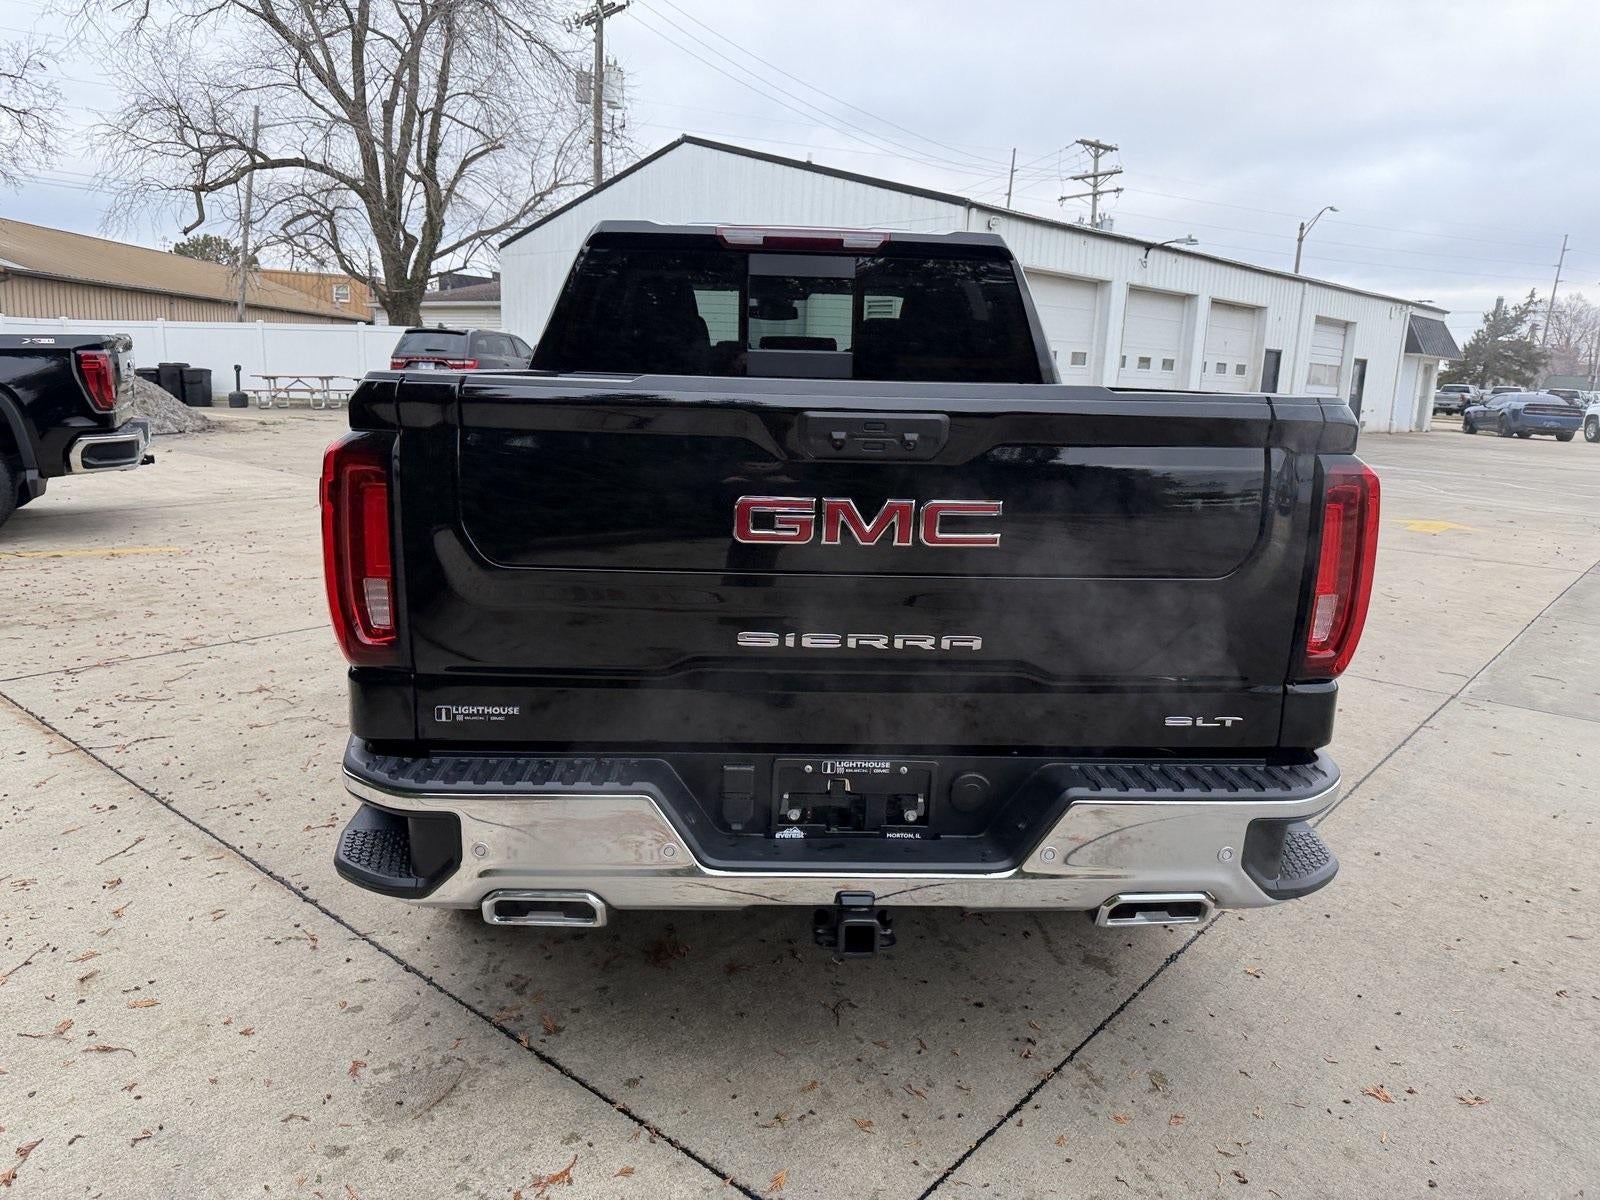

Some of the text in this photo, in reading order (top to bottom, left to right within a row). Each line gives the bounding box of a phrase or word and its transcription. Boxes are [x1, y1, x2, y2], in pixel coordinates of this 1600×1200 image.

[734, 495, 1003, 547] GMC
[737, 631, 982, 650] SIERRA
[452, 705, 519, 715] LIGHTHOUSE
[1165, 716, 1243, 727] SLT
